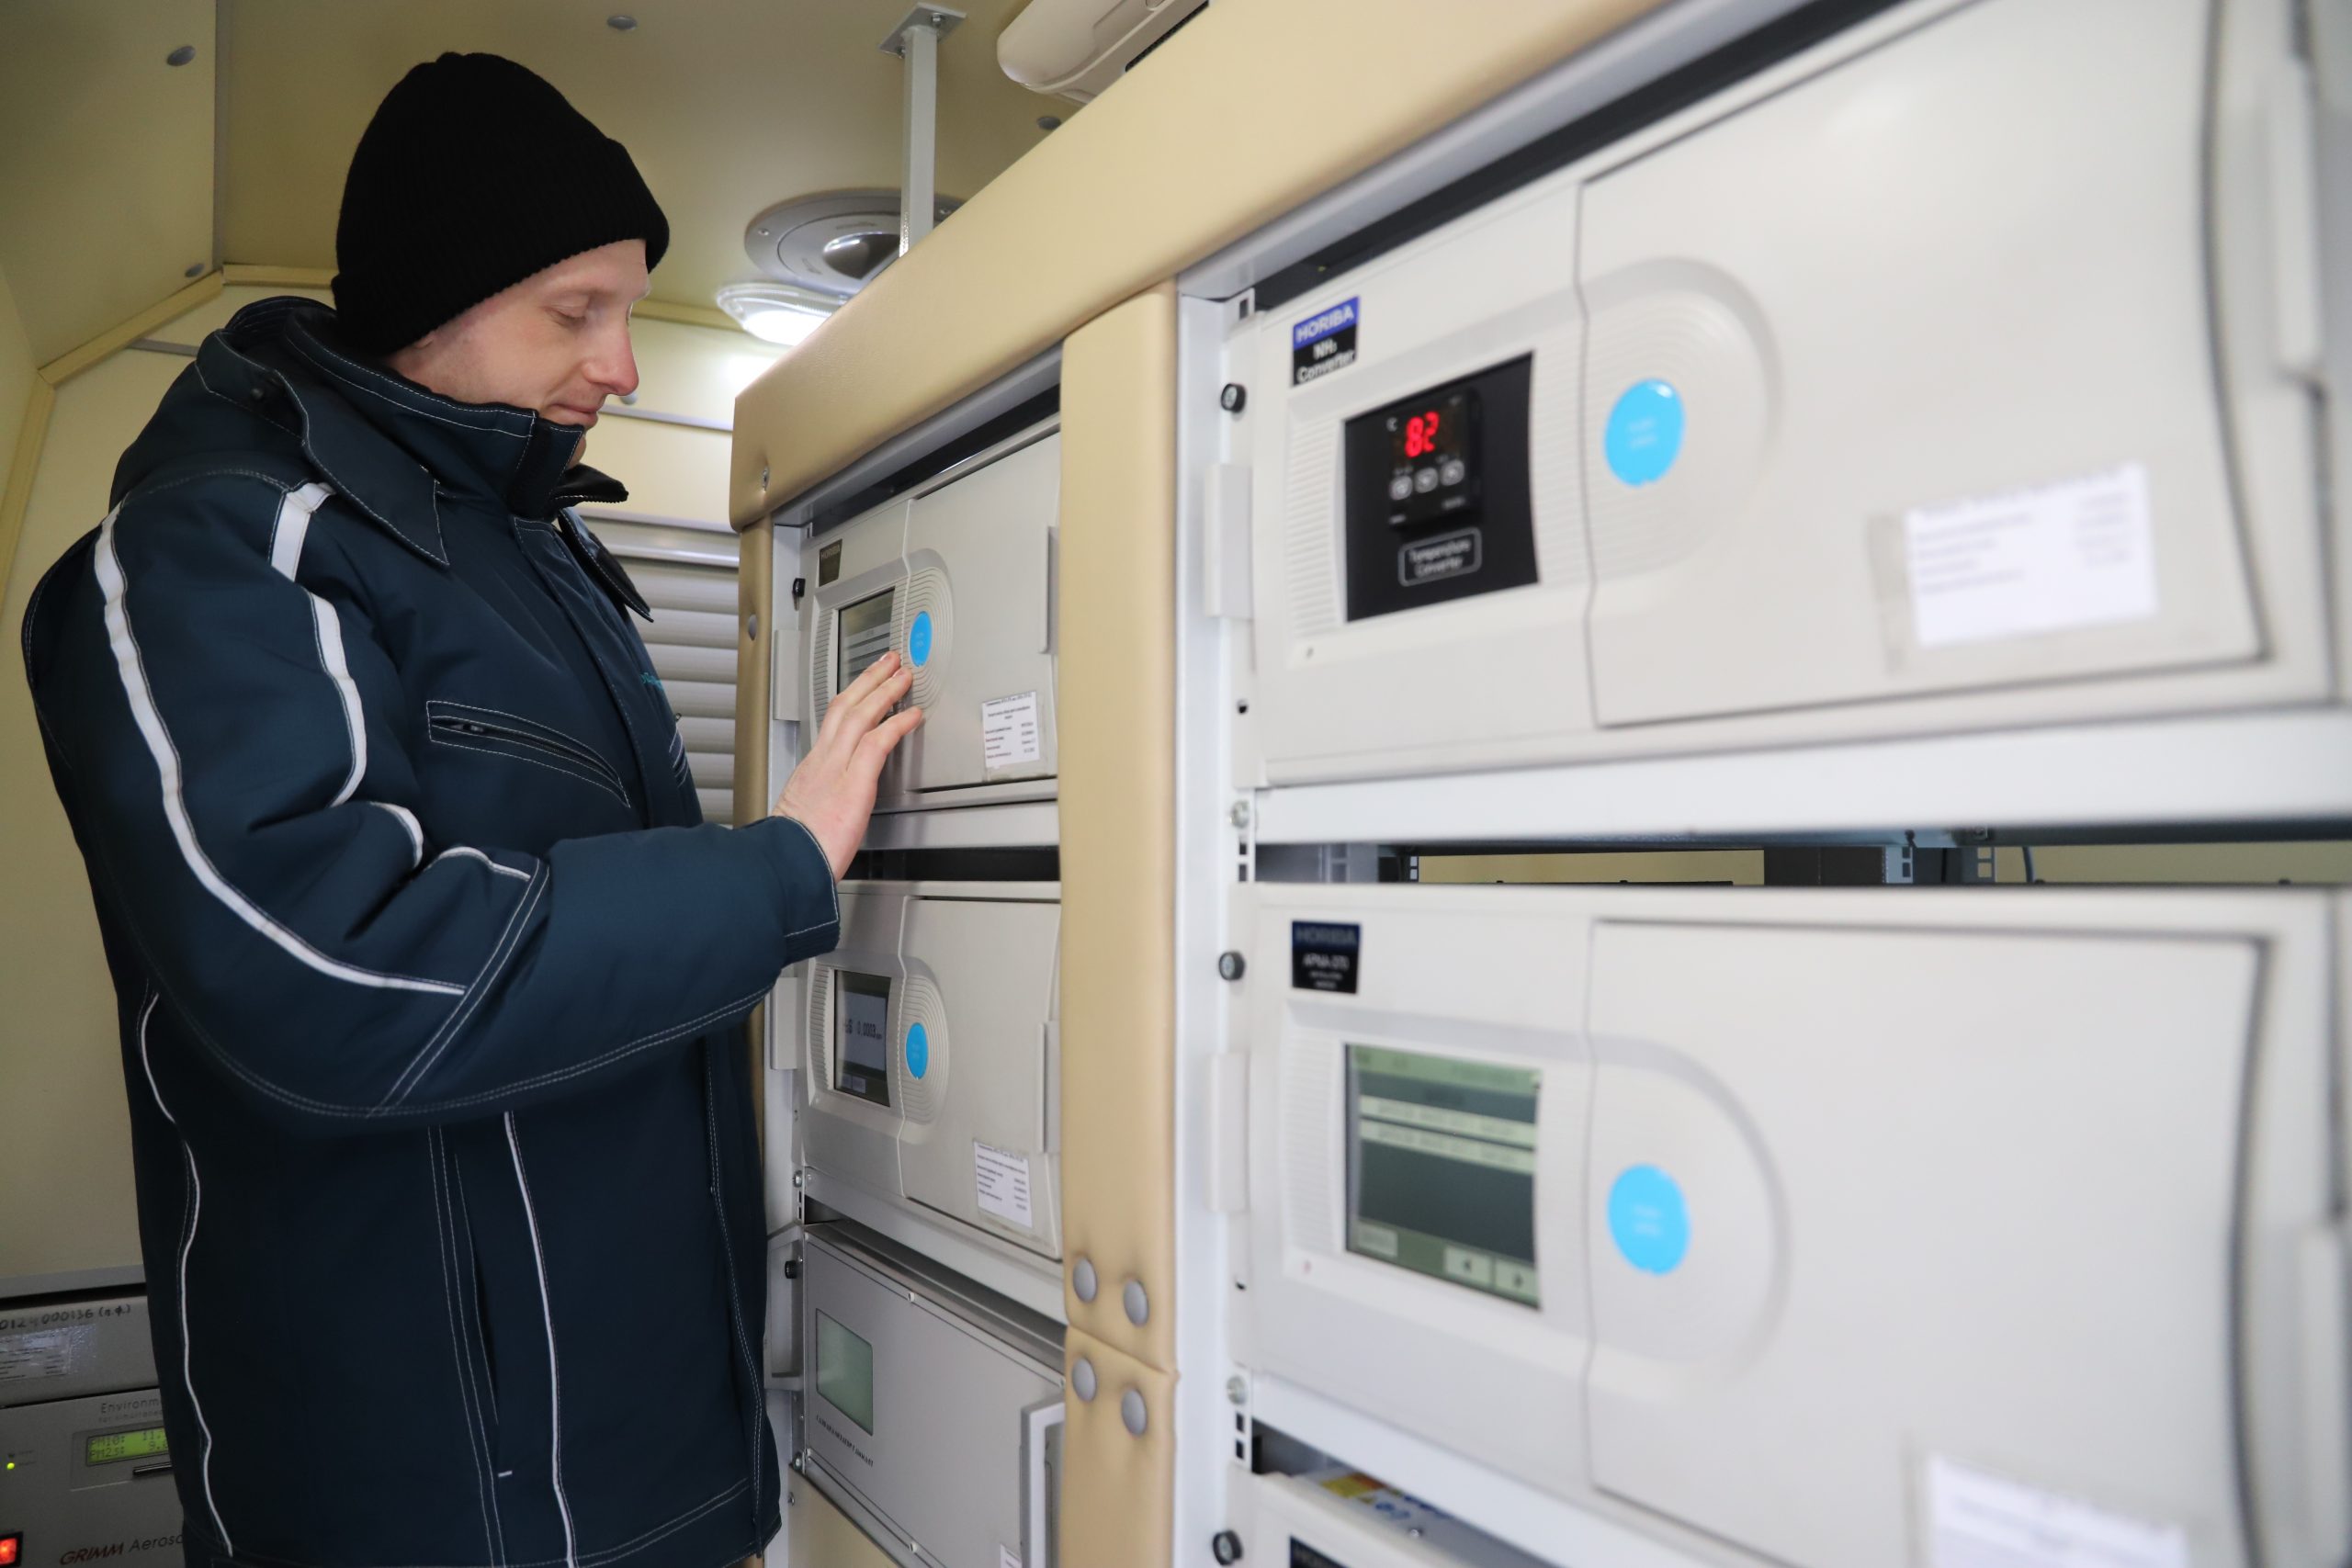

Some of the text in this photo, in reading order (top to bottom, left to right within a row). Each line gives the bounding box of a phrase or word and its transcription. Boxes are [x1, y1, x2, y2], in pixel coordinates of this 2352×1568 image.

[1295, 304, 1354, 344] HORIBA
[1296, 350, 1355, 384] Converter
[1404, 411, 1440, 457] 82
[60, 1541, 125, 1566] GRIMM
